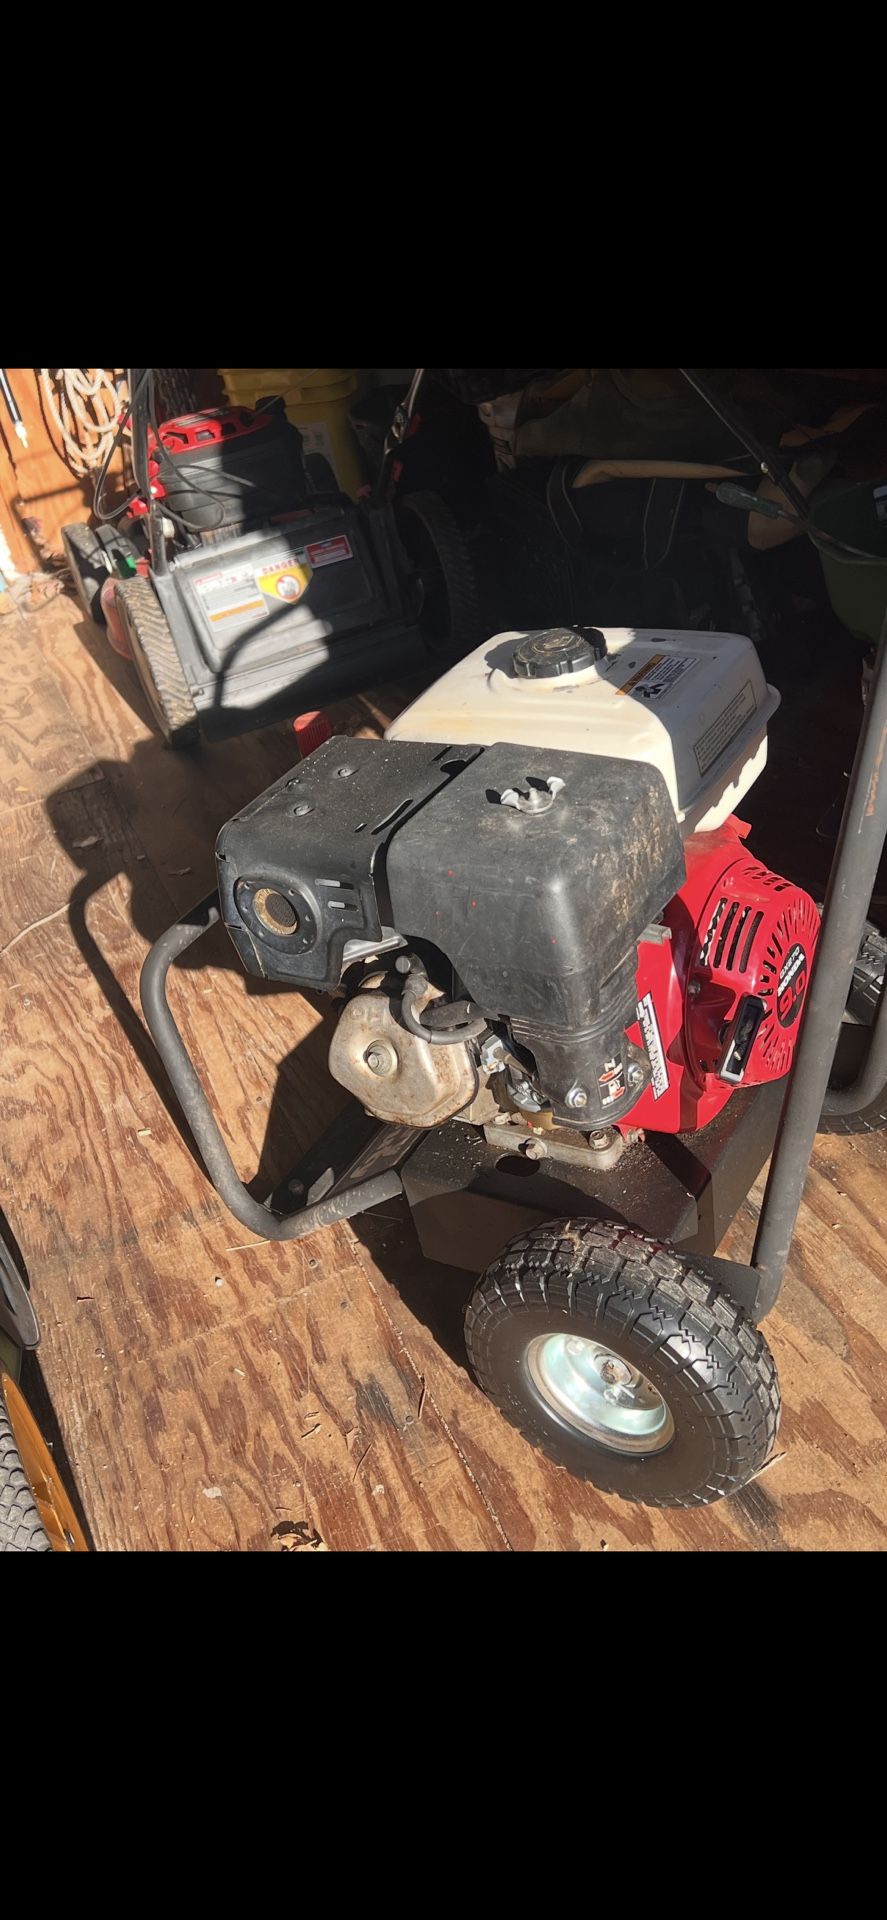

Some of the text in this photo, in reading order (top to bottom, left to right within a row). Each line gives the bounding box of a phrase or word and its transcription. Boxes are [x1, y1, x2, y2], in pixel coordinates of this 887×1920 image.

[262, 558, 299, 574] DANGER
[777, 953, 805, 996] HONDA
[780, 946, 800, 979] GX270
[779, 971, 805, 1021] 9.0
